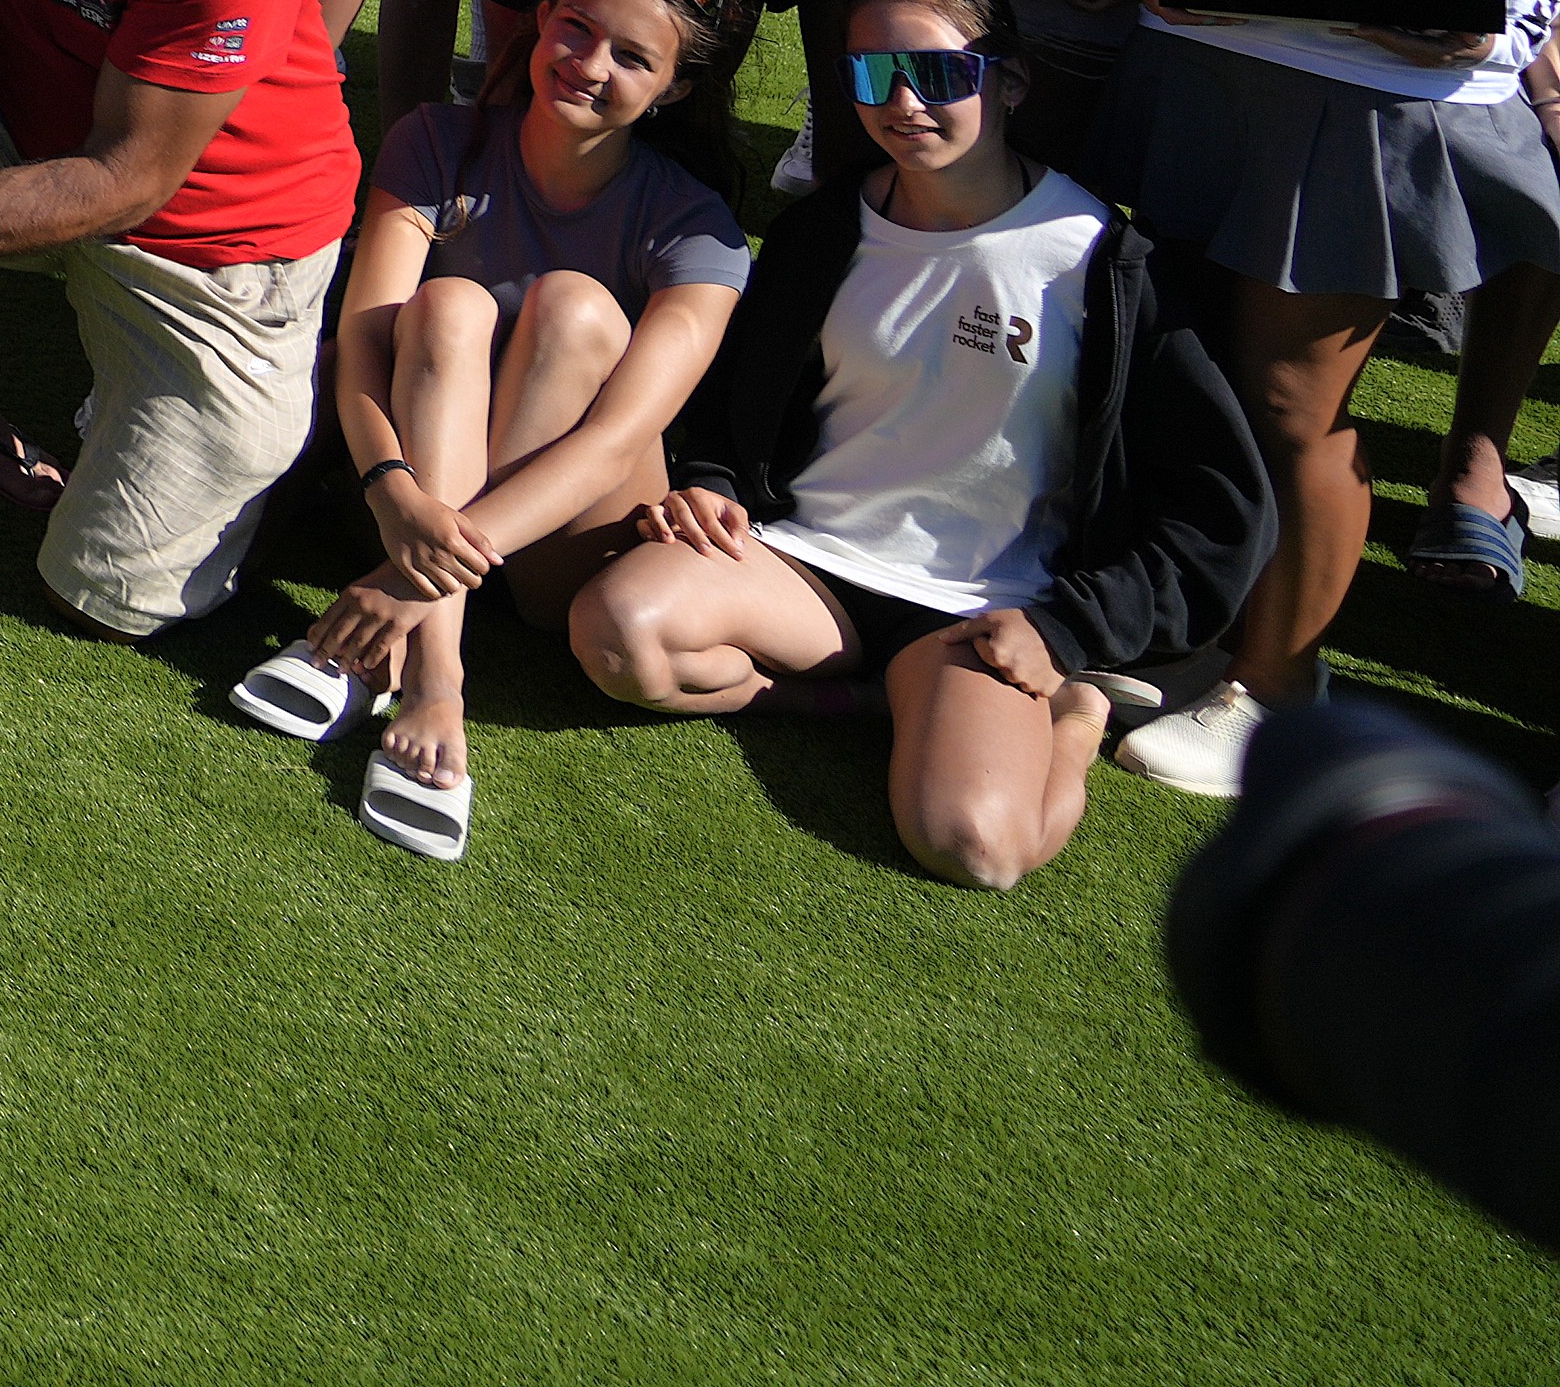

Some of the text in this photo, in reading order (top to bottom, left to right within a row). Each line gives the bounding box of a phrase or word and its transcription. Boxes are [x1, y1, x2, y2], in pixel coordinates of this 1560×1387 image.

[973, 305, 1001, 325] fast
[958, 316, 999, 339] faster
[952, 333, 997, 355] rocket
